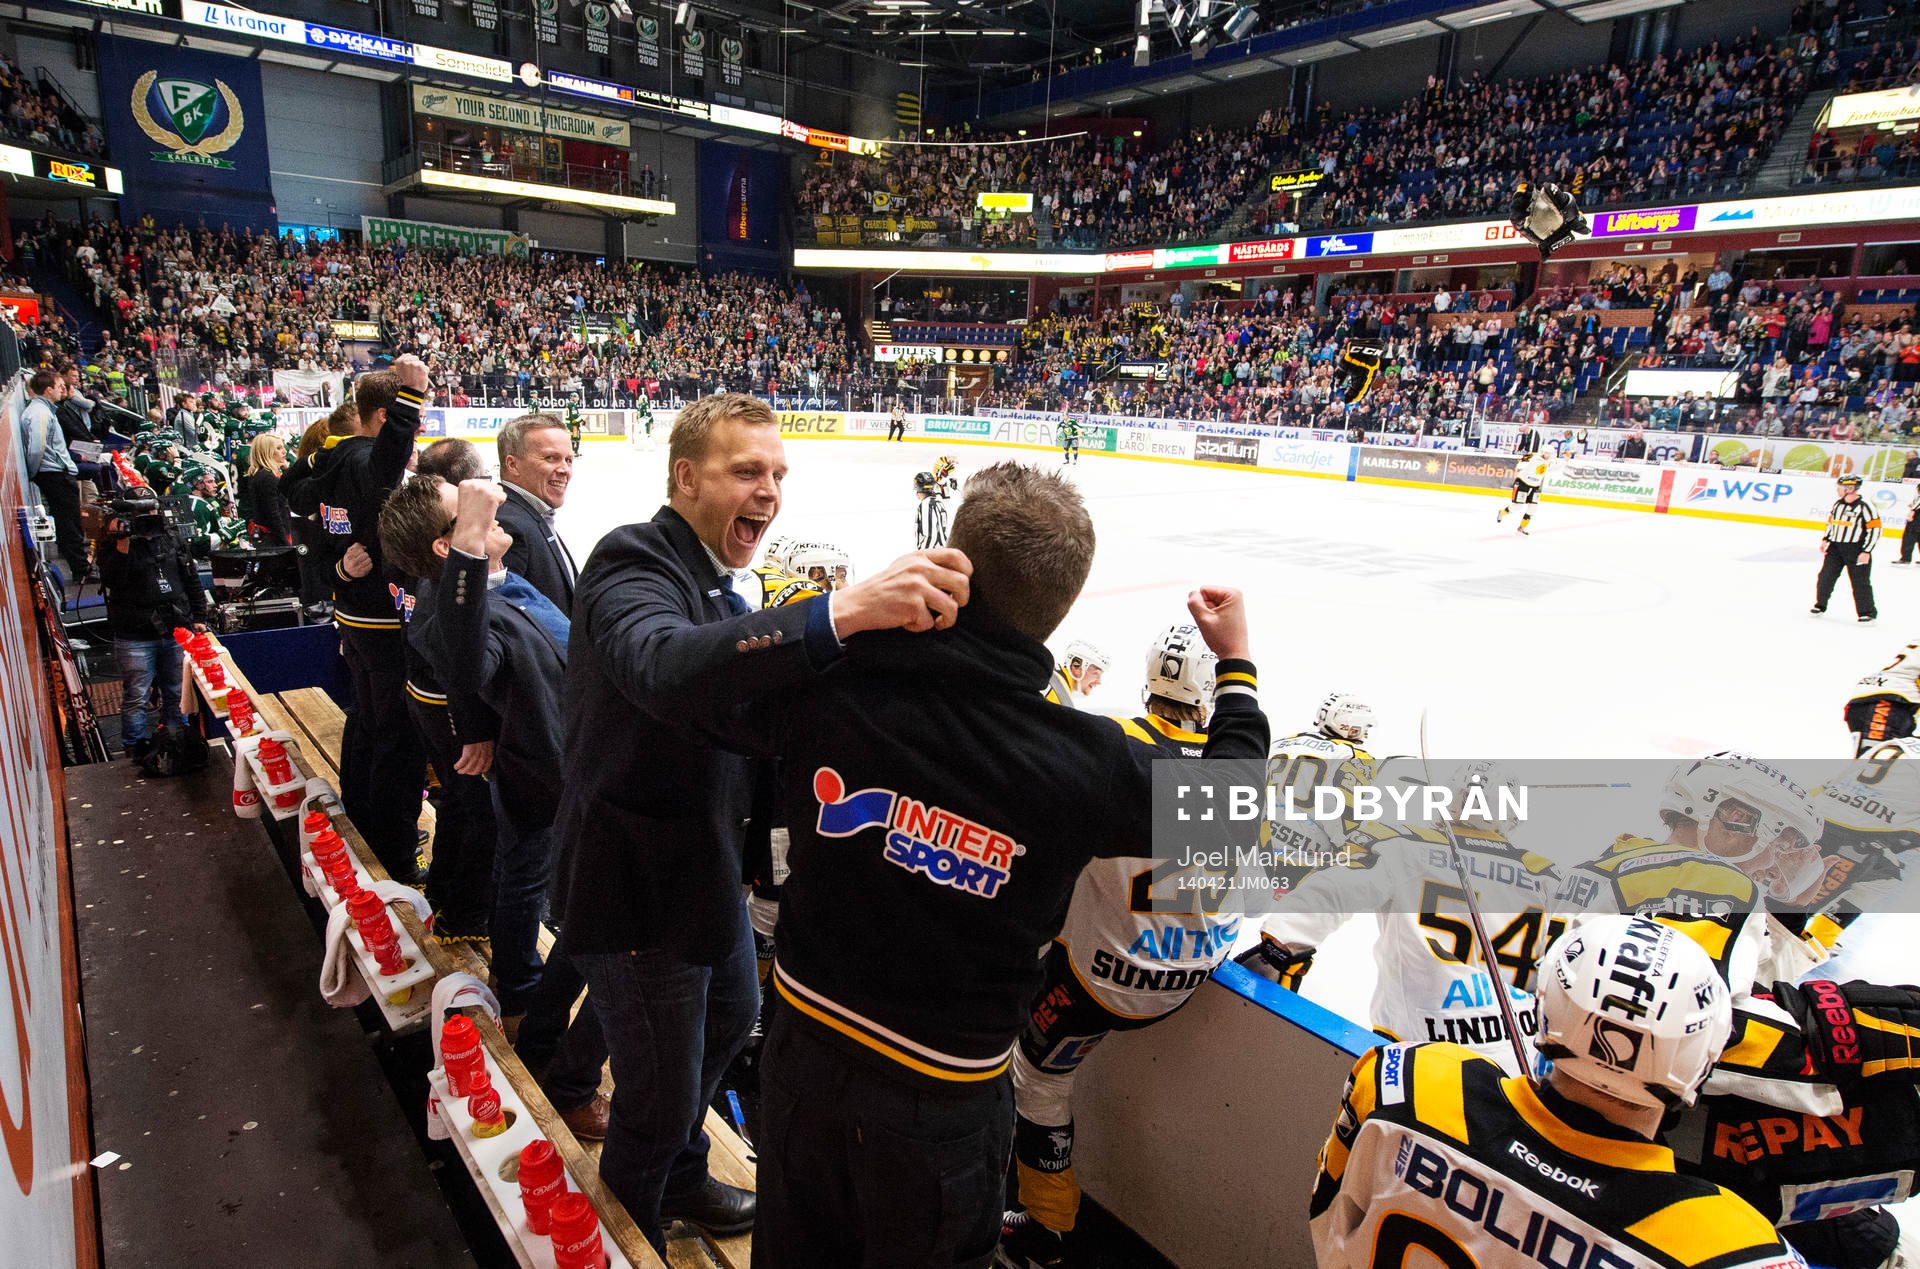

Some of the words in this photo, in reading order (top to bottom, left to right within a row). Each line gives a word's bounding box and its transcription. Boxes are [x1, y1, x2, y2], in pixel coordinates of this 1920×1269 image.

[225, 9, 286, 35] kranar
[475, 17, 496, 30] 1997
[588, 43, 609, 54] 2002
[455, 97, 485, 118] YOUR
[488, 105, 530, 125] SECOND
[167, 153, 220, 166] KARLSTAD
[1607, 213, 1680, 232] Löfbergs
[779, 413, 837, 434] Hertz
[870, 421, 913, 430] WENEC
[927, 420, 989, 432] BRUNZELLS
[1196, 439, 1258, 460] stadium
[1273, 446, 1335, 469] Scandjet
[1362, 457, 1422, 471] KARLSTAD
[1448, 461, 1518, 479] Swedban
[1547, 478, 1655, 497] LARSSON-RESMAN
[1722, 479, 1794, 504] WSP
[795, 565, 806, 574] 41
[1867, 700, 1893, 741] REPAY
[1702, 788, 1719, 803] 3
[893, 796, 1017, 870] INTER
[883, 830, 1011, 899] SPORT
[1428, 849, 1541, 893] BLIDE
[1418, 879, 1545, 989] 54
[1385, 1048, 1401, 1087] SPORT
[1713, 1106, 1864, 1165] REPAY
[1508, 1140, 1600, 1199] Reebok
[1404, 1143, 1642, 1269] BOLIDE
